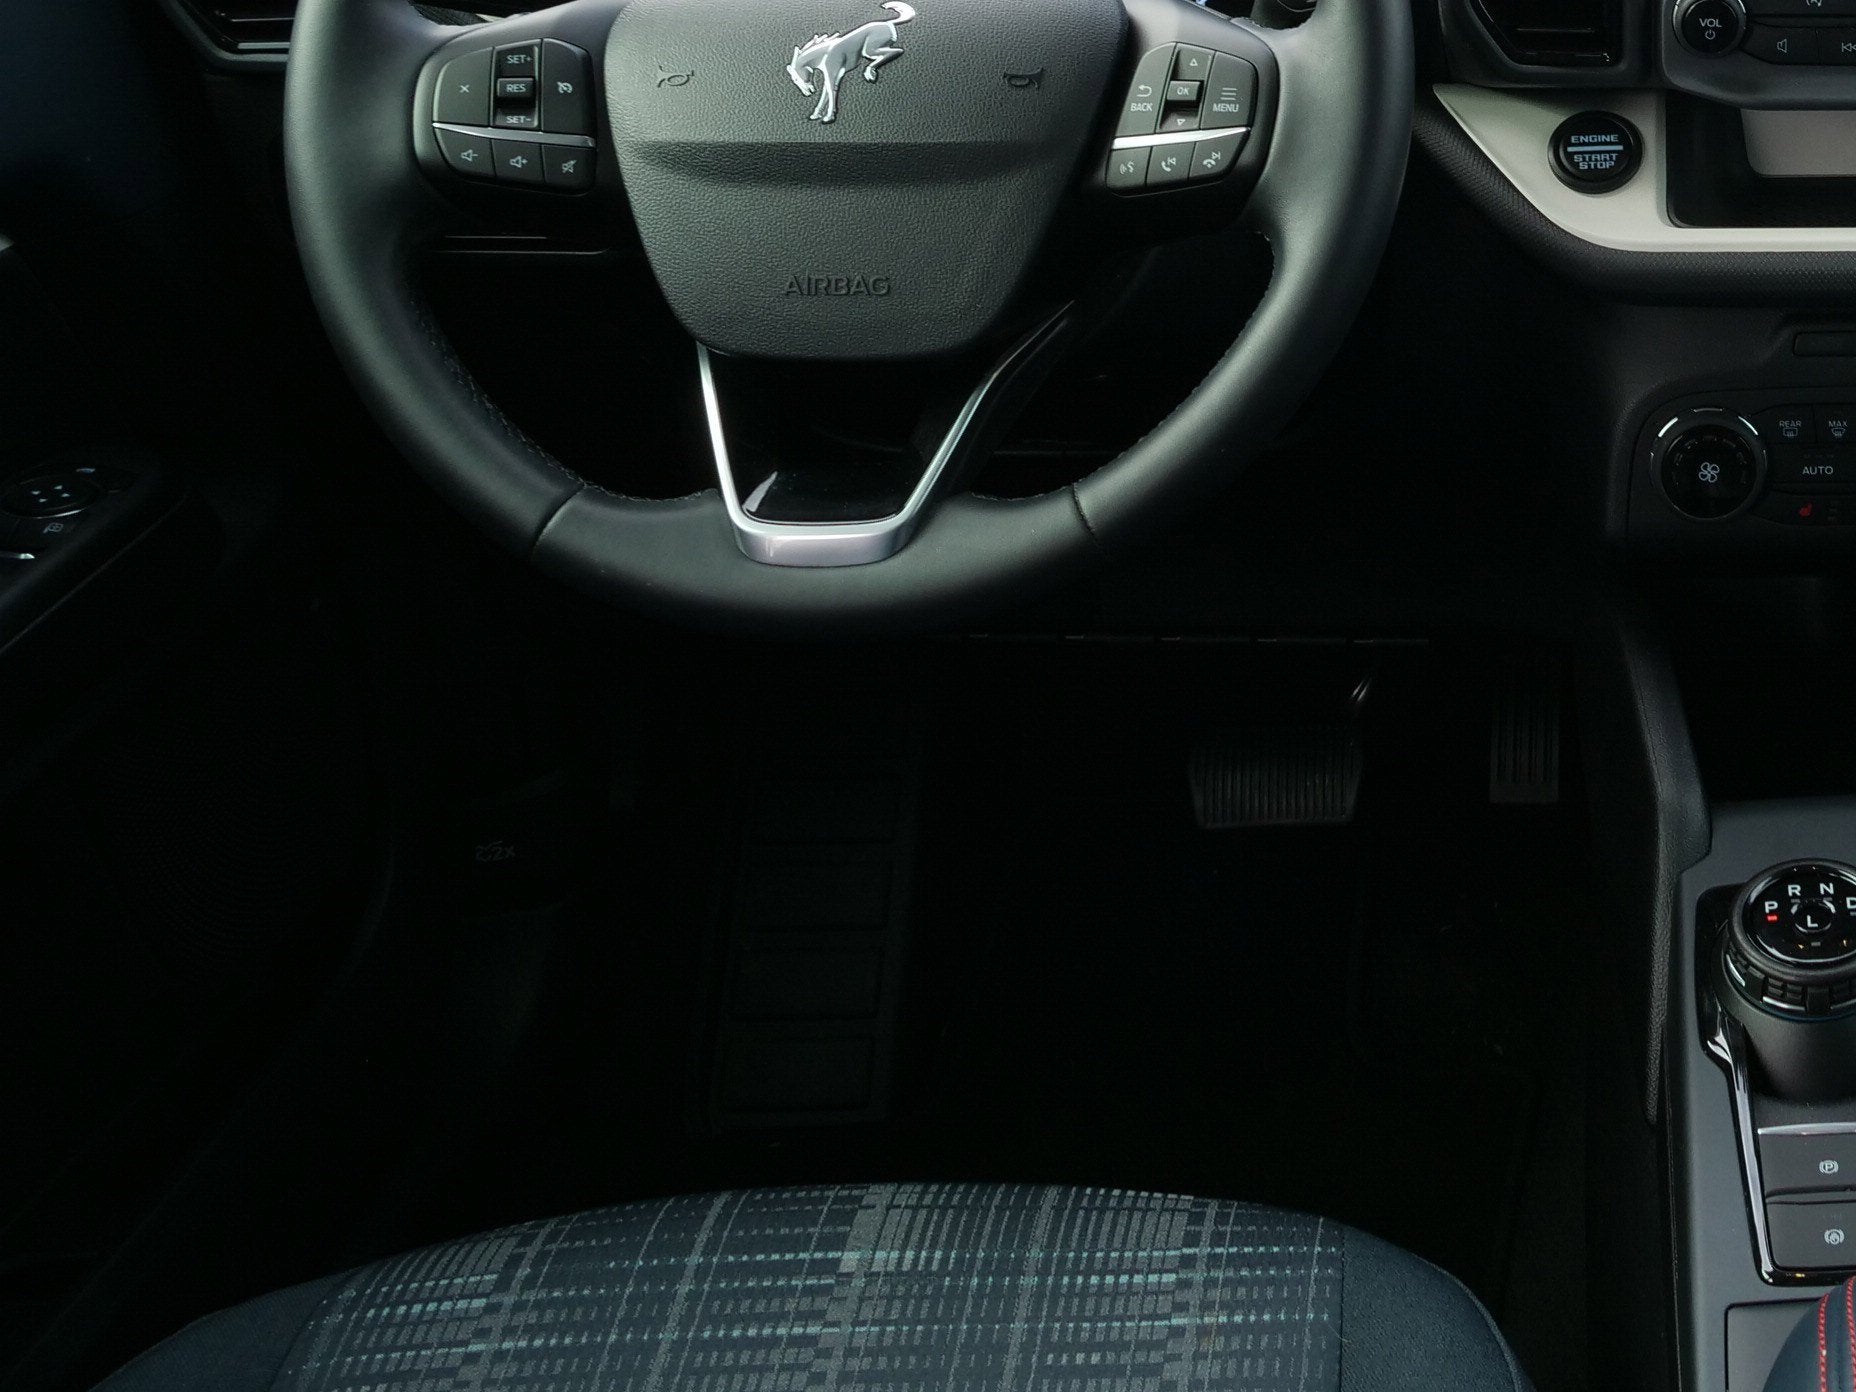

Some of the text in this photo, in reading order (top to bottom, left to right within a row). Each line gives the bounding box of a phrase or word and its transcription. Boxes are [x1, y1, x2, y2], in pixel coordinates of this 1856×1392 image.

[1699, 18, 1722, 28] VOL
[506, 83, 526, 93] RES
[1176, 86, 1190, 95] OK
[1130, 102, 1153, 112] BACK
[1212, 103, 1239, 113] MENU
[1571, 134, 1619, 144] ENGINE
[1573, 153, 1619, 162] START
[1579, 161, 1615, 170] STOP
[785, 274, 891, 297] AIRBAG
[1779, 420, 1801, 428] REAR
[1828, 420, 1848, 428] MAX
[1802, 466, 1834, 476] AUTO
[1787, 884, 1802, 897] R
[1819, 882, 1835, 895] N
[1764, 900, 1779, 914] P
[1806, 914, 1818, 928] L
